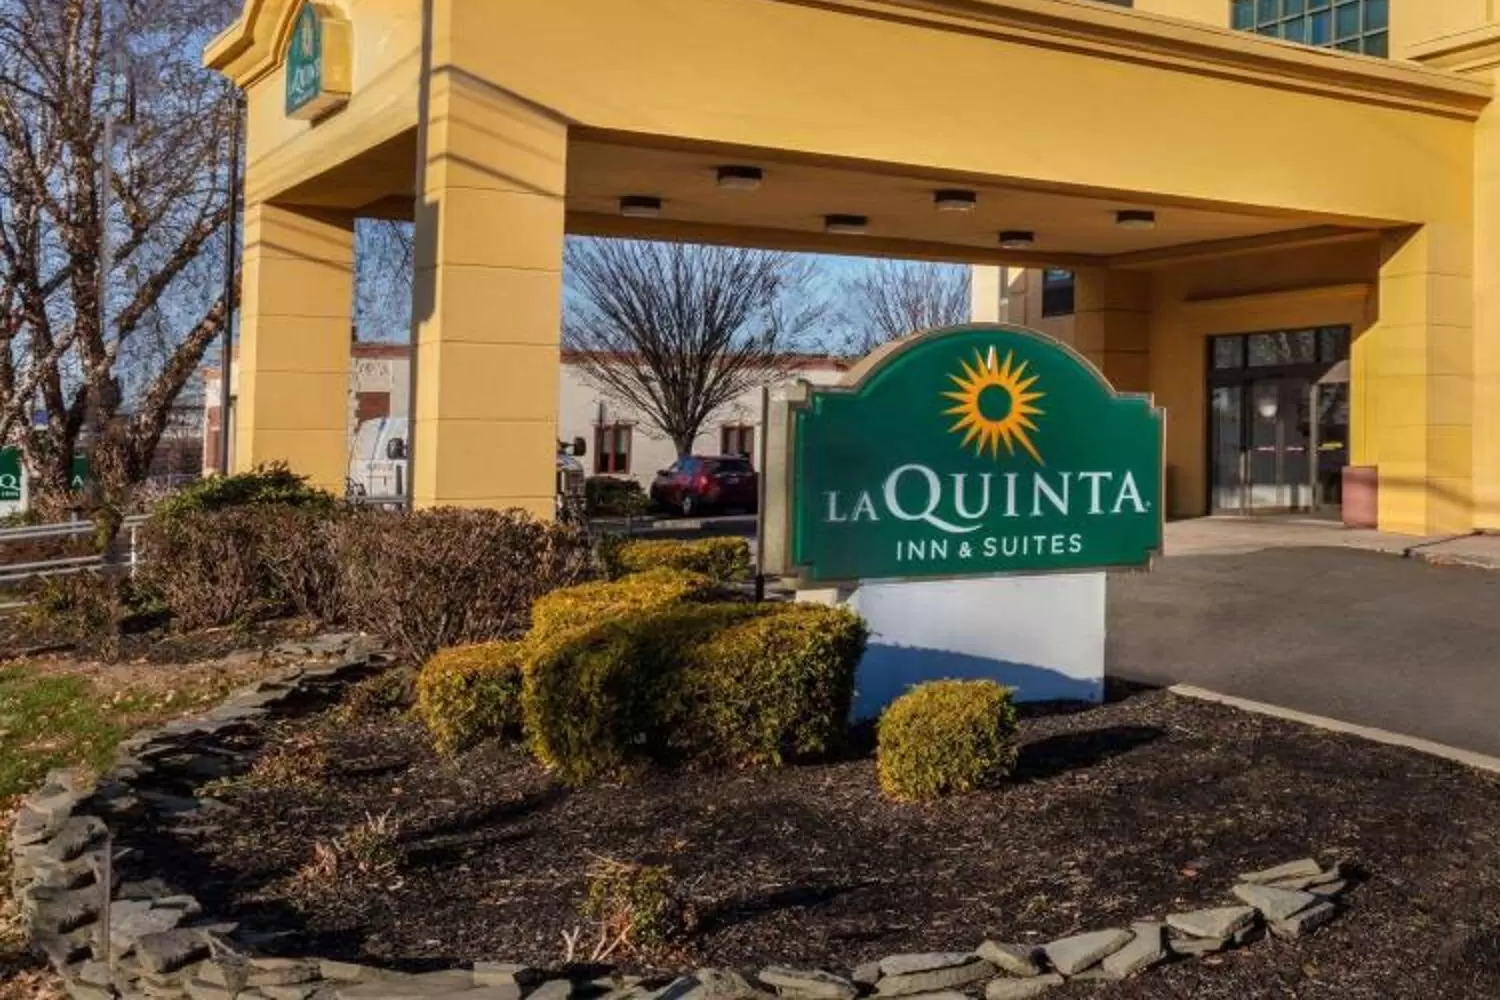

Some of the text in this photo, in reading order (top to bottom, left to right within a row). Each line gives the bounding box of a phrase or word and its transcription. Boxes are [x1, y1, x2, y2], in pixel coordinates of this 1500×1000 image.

[824, 463, 1148, 533] LA QUINTA
[896, 533, 1083, 561] INN & SUITES
